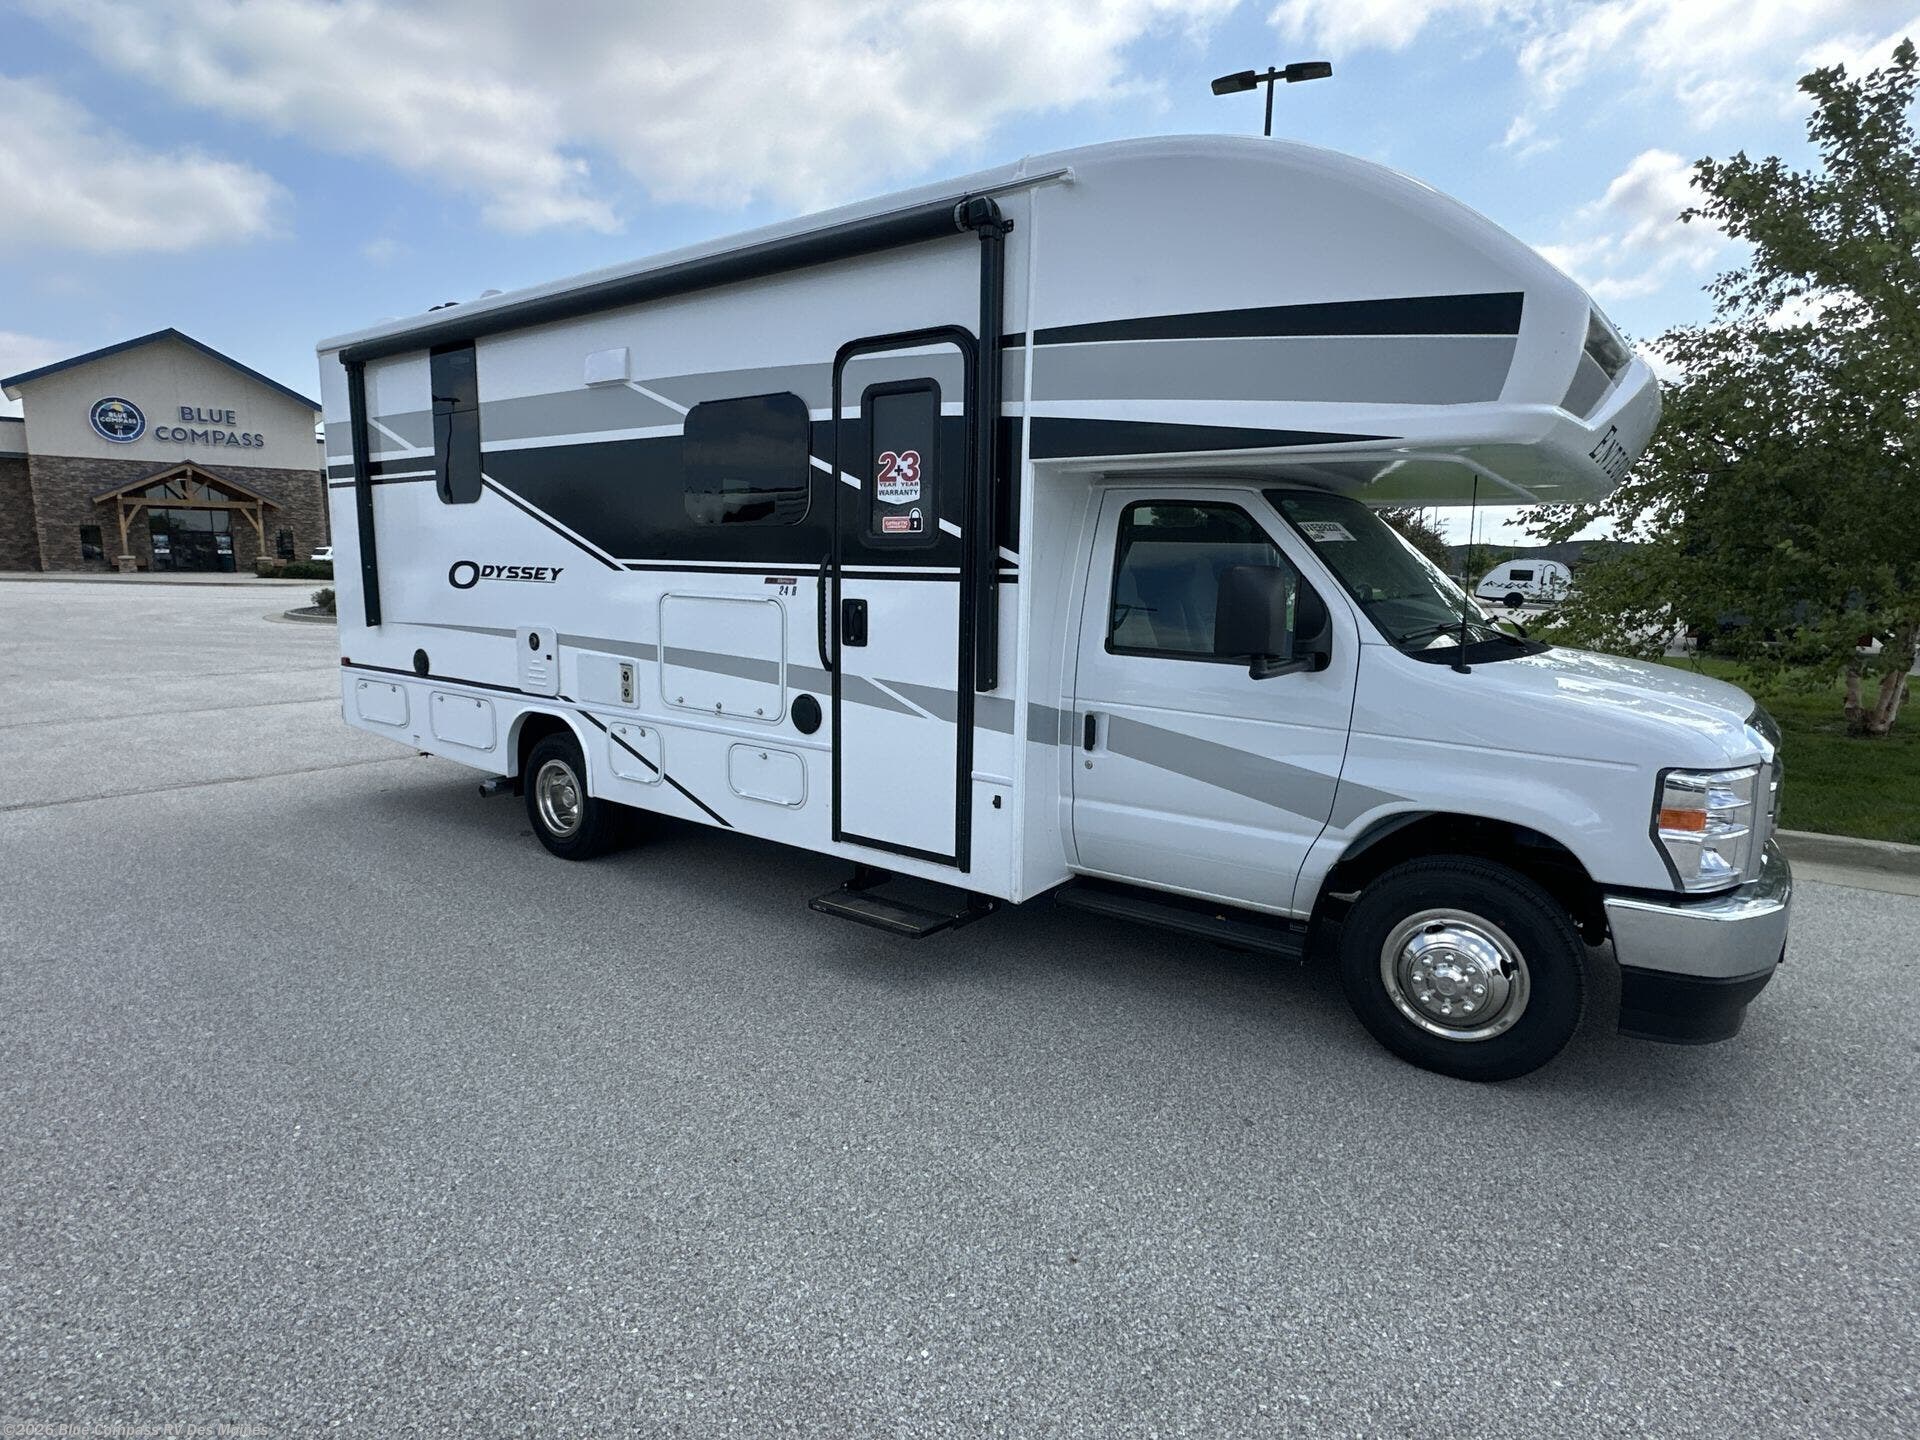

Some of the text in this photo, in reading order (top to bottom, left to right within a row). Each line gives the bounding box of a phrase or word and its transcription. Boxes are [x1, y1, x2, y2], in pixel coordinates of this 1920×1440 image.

[99, 416, 137, 424] COMPASS
[180, 405, 236, 425] BLUE
[155, 425, 265, 448] COMPASS
[878, 489, 919, 497] WARRANTY
[448, 560, 564, 589] ODYSSEY
